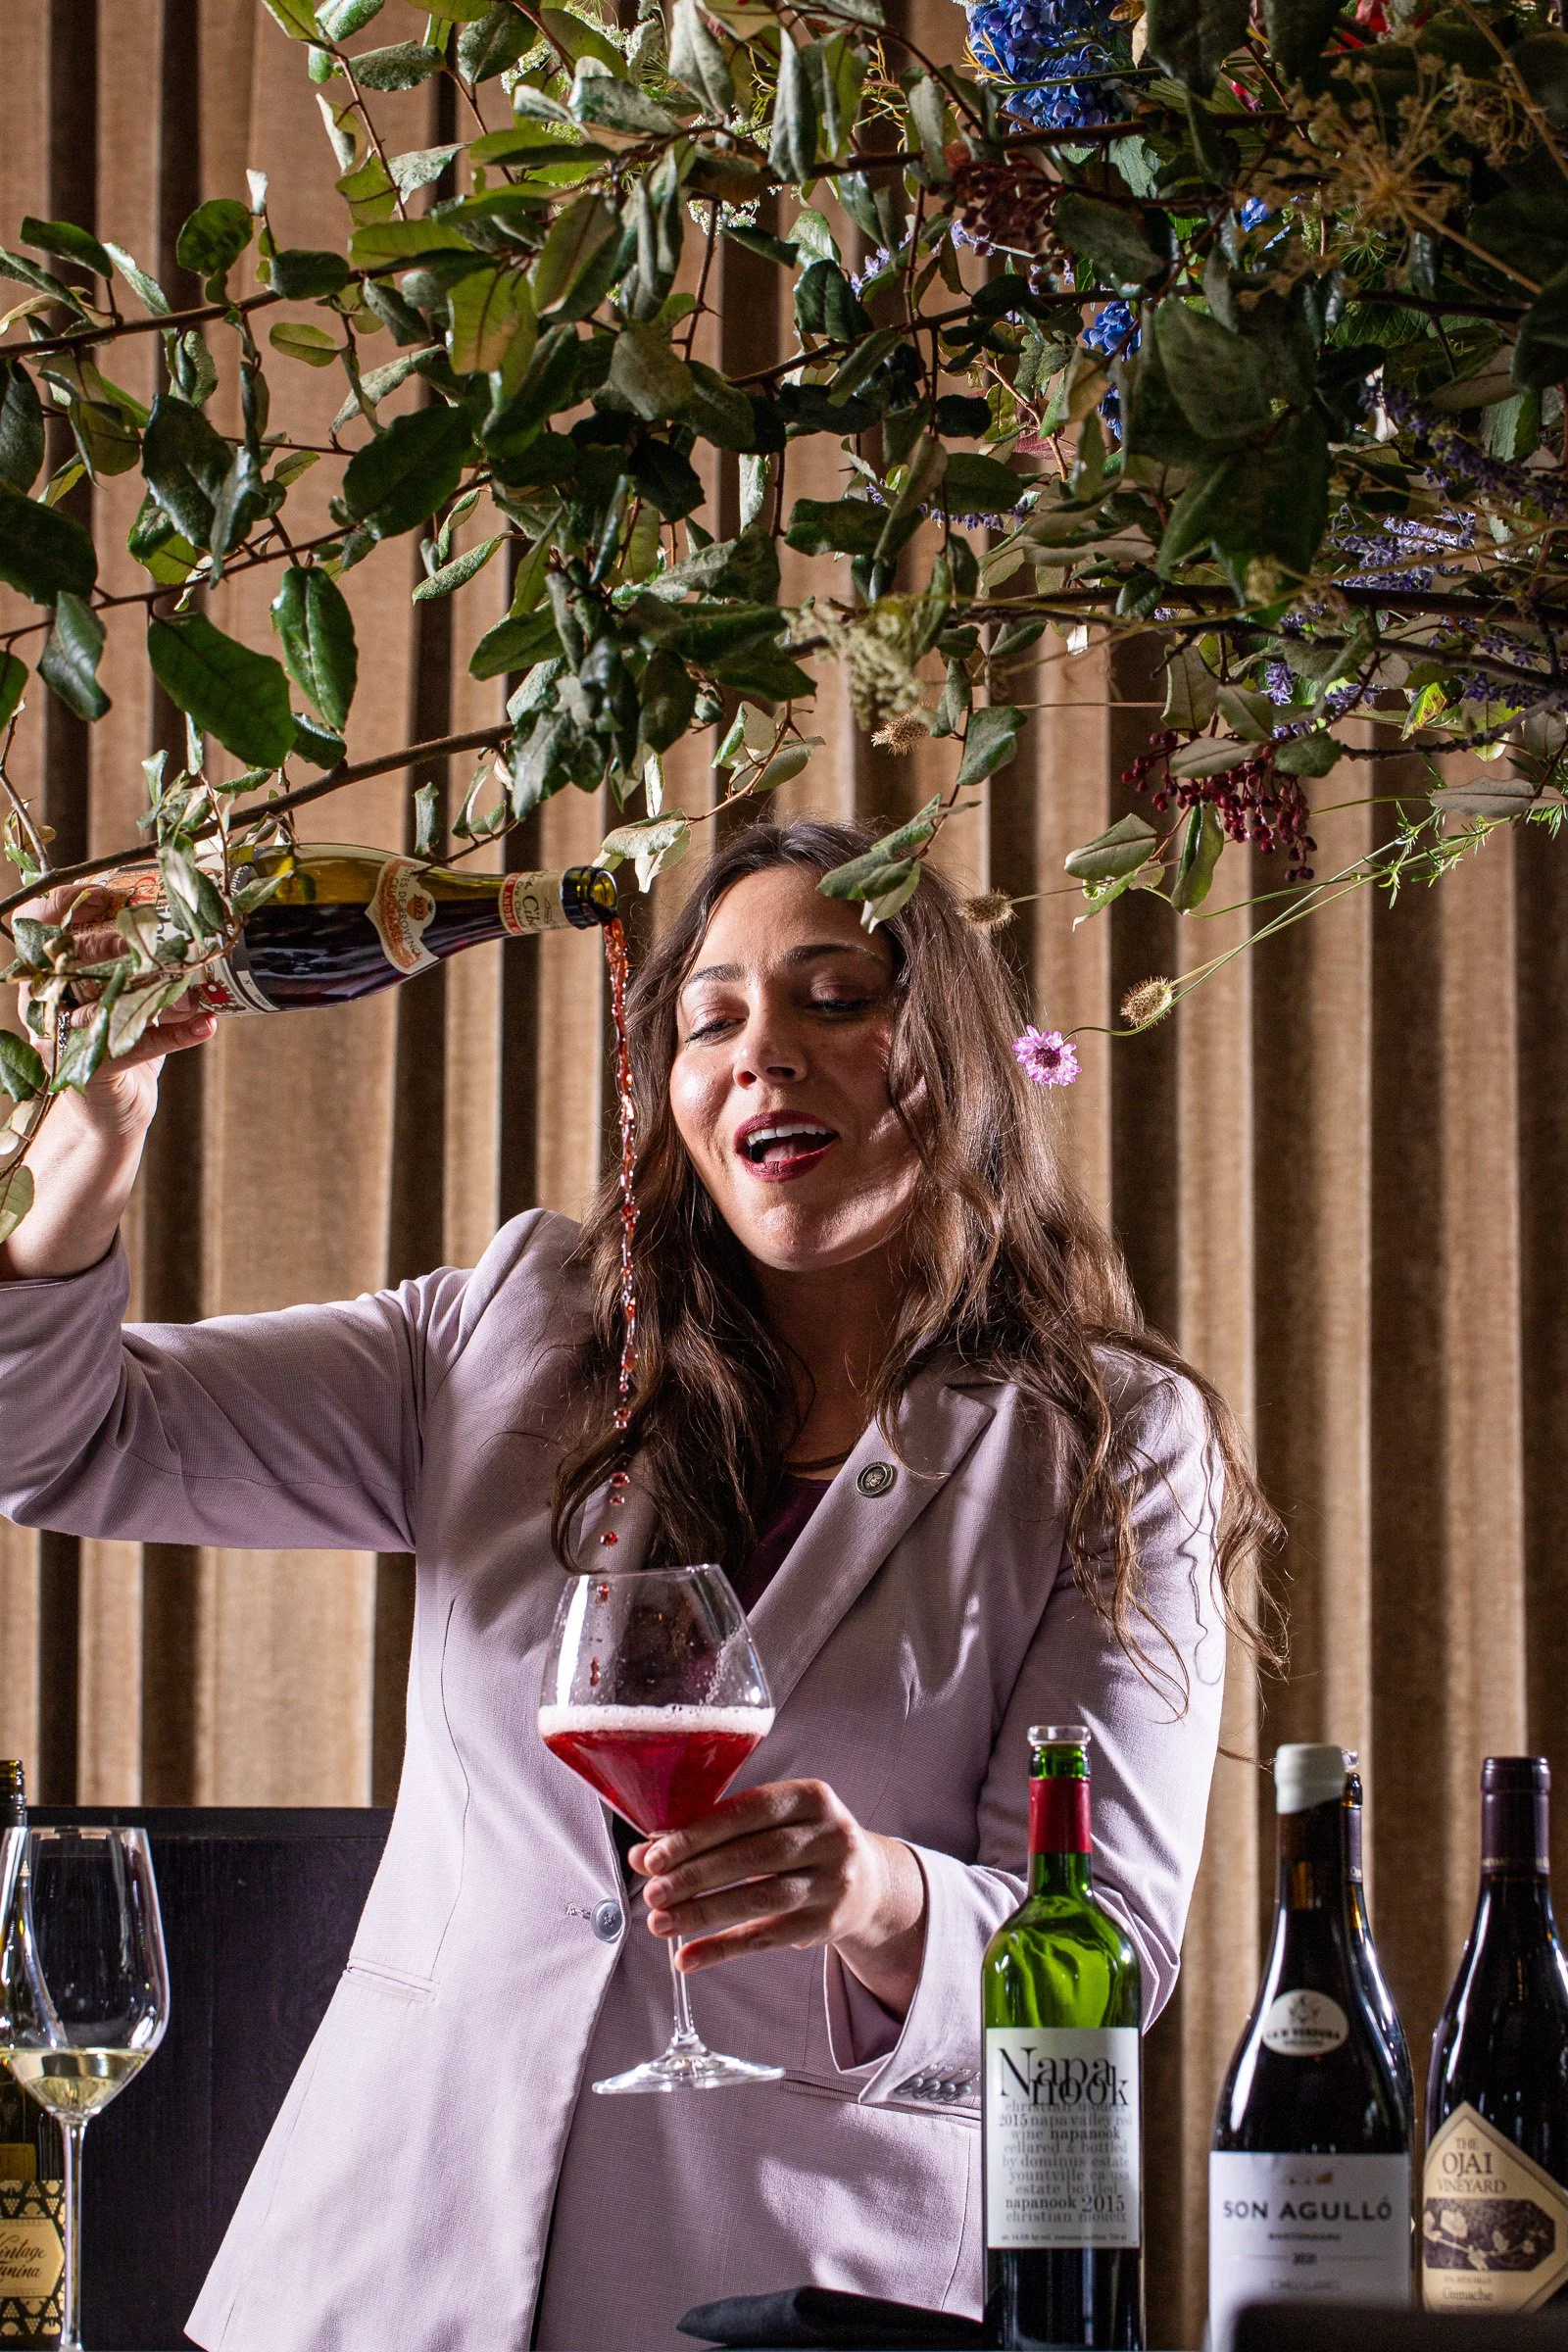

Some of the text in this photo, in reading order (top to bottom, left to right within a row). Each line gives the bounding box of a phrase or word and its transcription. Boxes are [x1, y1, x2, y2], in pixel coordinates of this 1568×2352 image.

[398, 890, 408, 906] DE
[999, 2047, 1112, 2096] Napa
[1032, 2065, 1129, 2106] nook
[999, 2113, 1028, 2127] 2015
[1011, 2126, 1120, 2143] wine napanook
[1004, 2139, 1060, 2153] cellared
[1455, 2137, 1479, 2149] THE
[1443, 2150, 1493, 2179] OJAI
[1015, 2183, 1061, 2195] estate
[1437, 2179, 1507, 2193] VINEYARD
[1005, 2194, 1125, 2213] napanook 2015
[1224, 2194, 1393, 2221] SON AGULLÓ
[1005, 2211, 1073, 2223] christian
